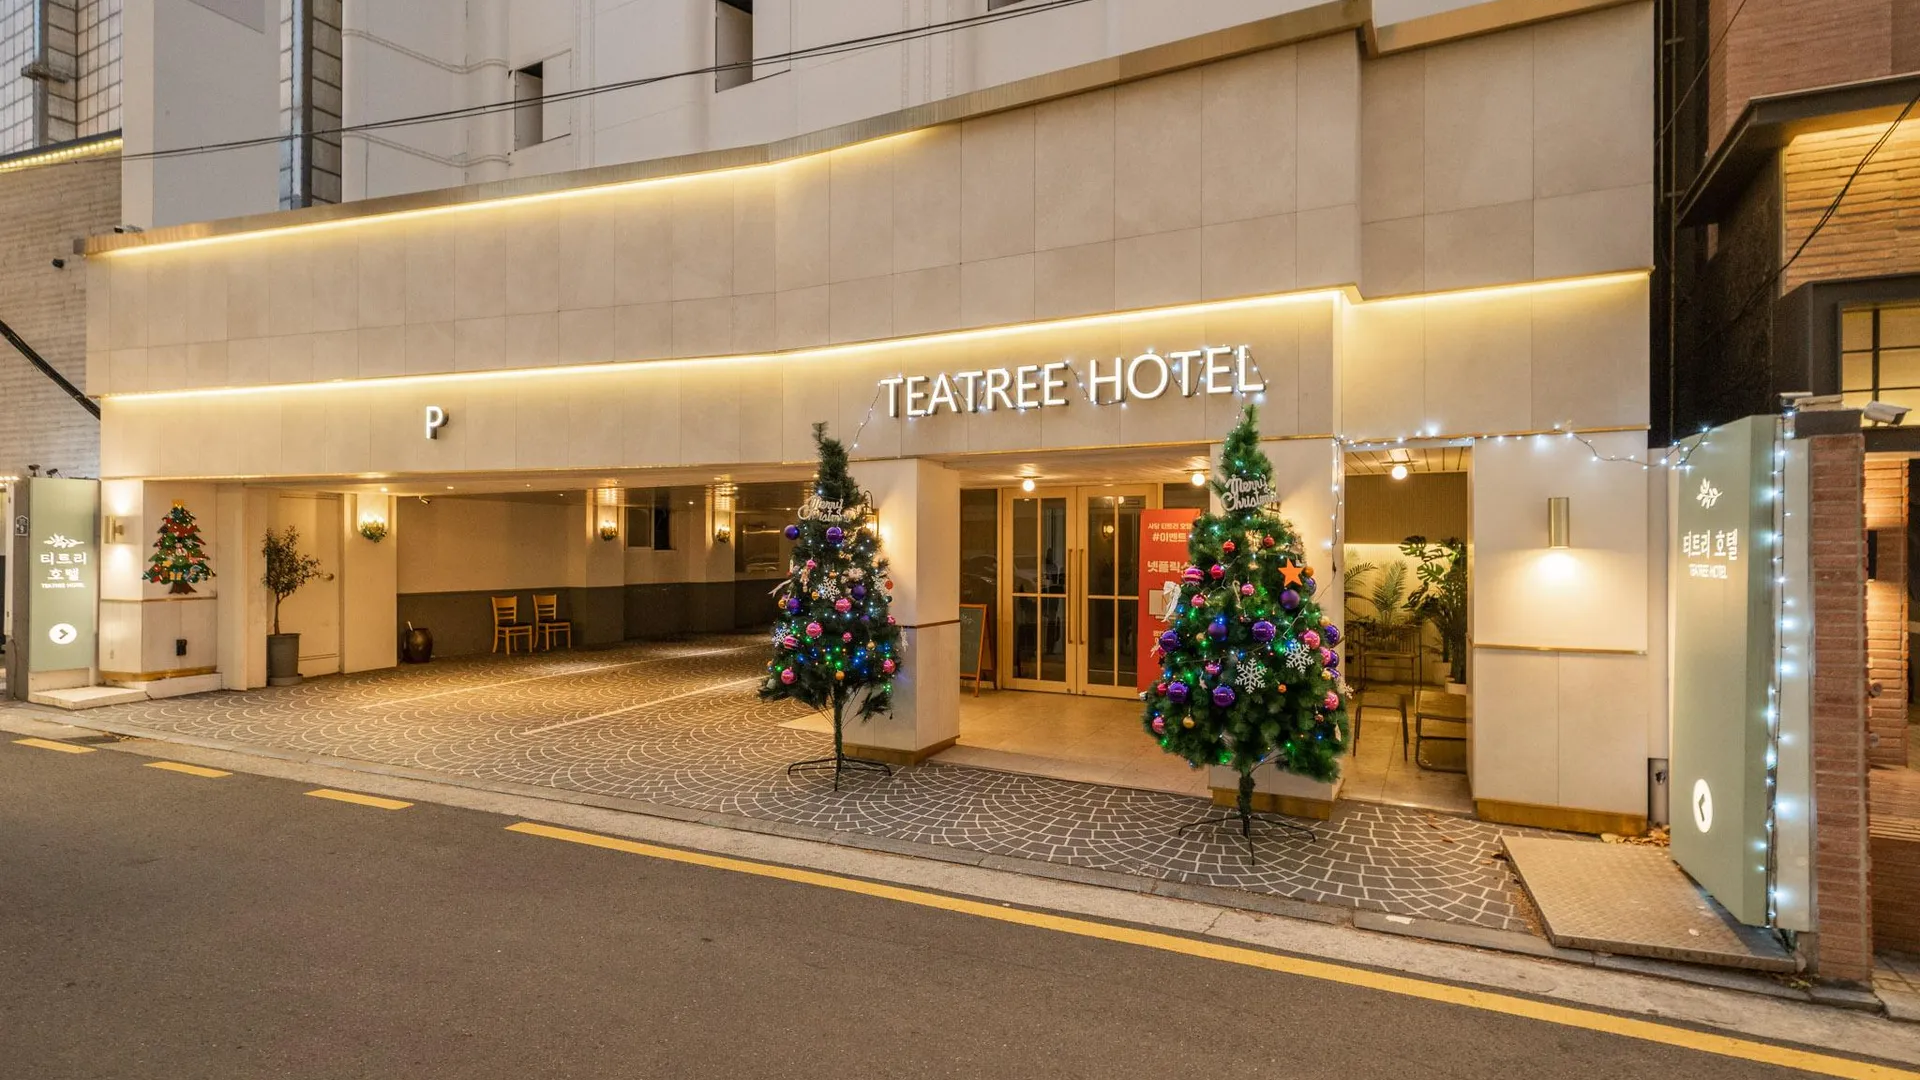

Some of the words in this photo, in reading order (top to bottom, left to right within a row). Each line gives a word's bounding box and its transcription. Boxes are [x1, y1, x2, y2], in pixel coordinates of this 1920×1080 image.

[880, 362, 1068, 417] TEATREE
[1090, 345, 1265, 403] HOTEL
[426, 405, 445, 439] P
[1225, 474, 1268, 493] Merry
[798, 504, 851, 522] Chistm
[1152, 532, 1187, 542] #이벤트
[1682, 530, 1710, 559] 티트리
[1714, 528, 1738, 560] 호텔
[40, 551, 86, 565] 티트리
[47, 567, 79, 581] 호텔
